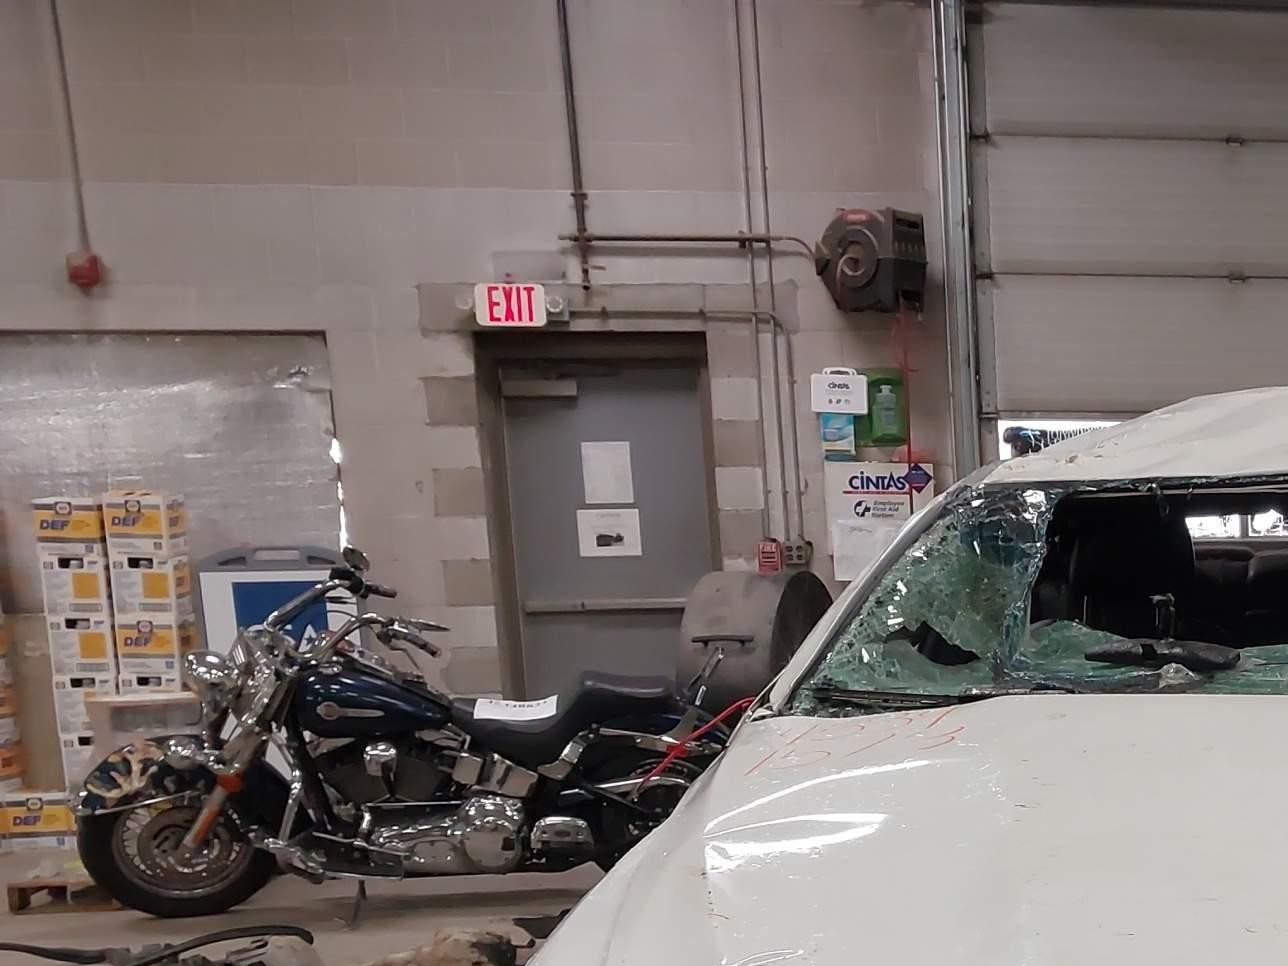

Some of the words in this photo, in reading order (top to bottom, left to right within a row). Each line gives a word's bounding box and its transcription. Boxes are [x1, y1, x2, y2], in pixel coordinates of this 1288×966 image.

[488, 286, 534, 322] EXIT
[848, 470, 906, 491] CINTAS
[39, 519, 70, 530] DEF
[111, 516, 140, 528] DEF
[124, 637, 149, 647] DEF
[13, 815, 41, 826] DEF
